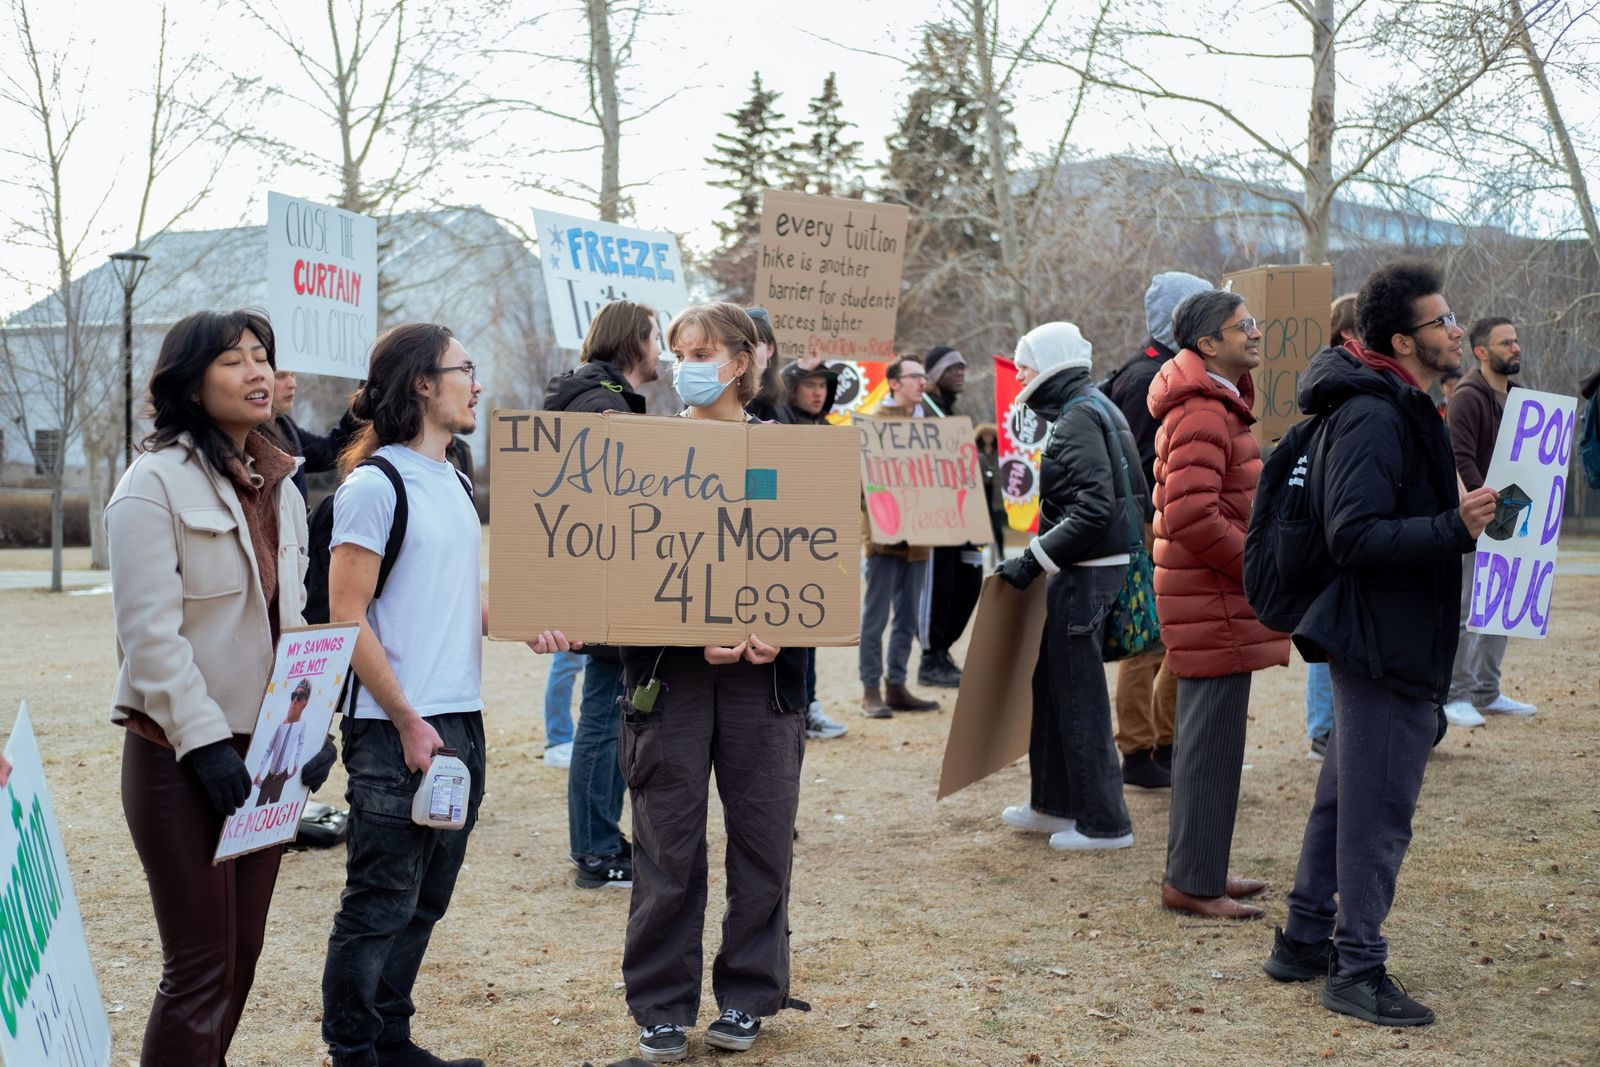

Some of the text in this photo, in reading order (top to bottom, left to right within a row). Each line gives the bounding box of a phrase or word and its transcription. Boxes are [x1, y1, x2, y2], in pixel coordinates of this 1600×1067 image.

[286, 201, 355, 260] CLOSE THE
[776, 211, 898, 254] every tuition
[566, 227, 675, 283] FREEZE
[763, 245, 870, 278] hike is another
[293, 258, 362, 307] CURTAIN
[769, 274, 896, 310] barrier for students
[291, 305, 319, 357] ON
[773, 309, 864, 339] access higher
[872, 420, 942, 450] YEAR
[499, 415, 747, 503] IN Alberta
[534, 503, 839, 580] You Pay More
[654, 562, 826, 629] 4 Less
[287, 636, 344, 658] MY SAVINGS
[287, 658, 328, 677] ARE NOT
[223, 801, 299, 840] KENOUGH
